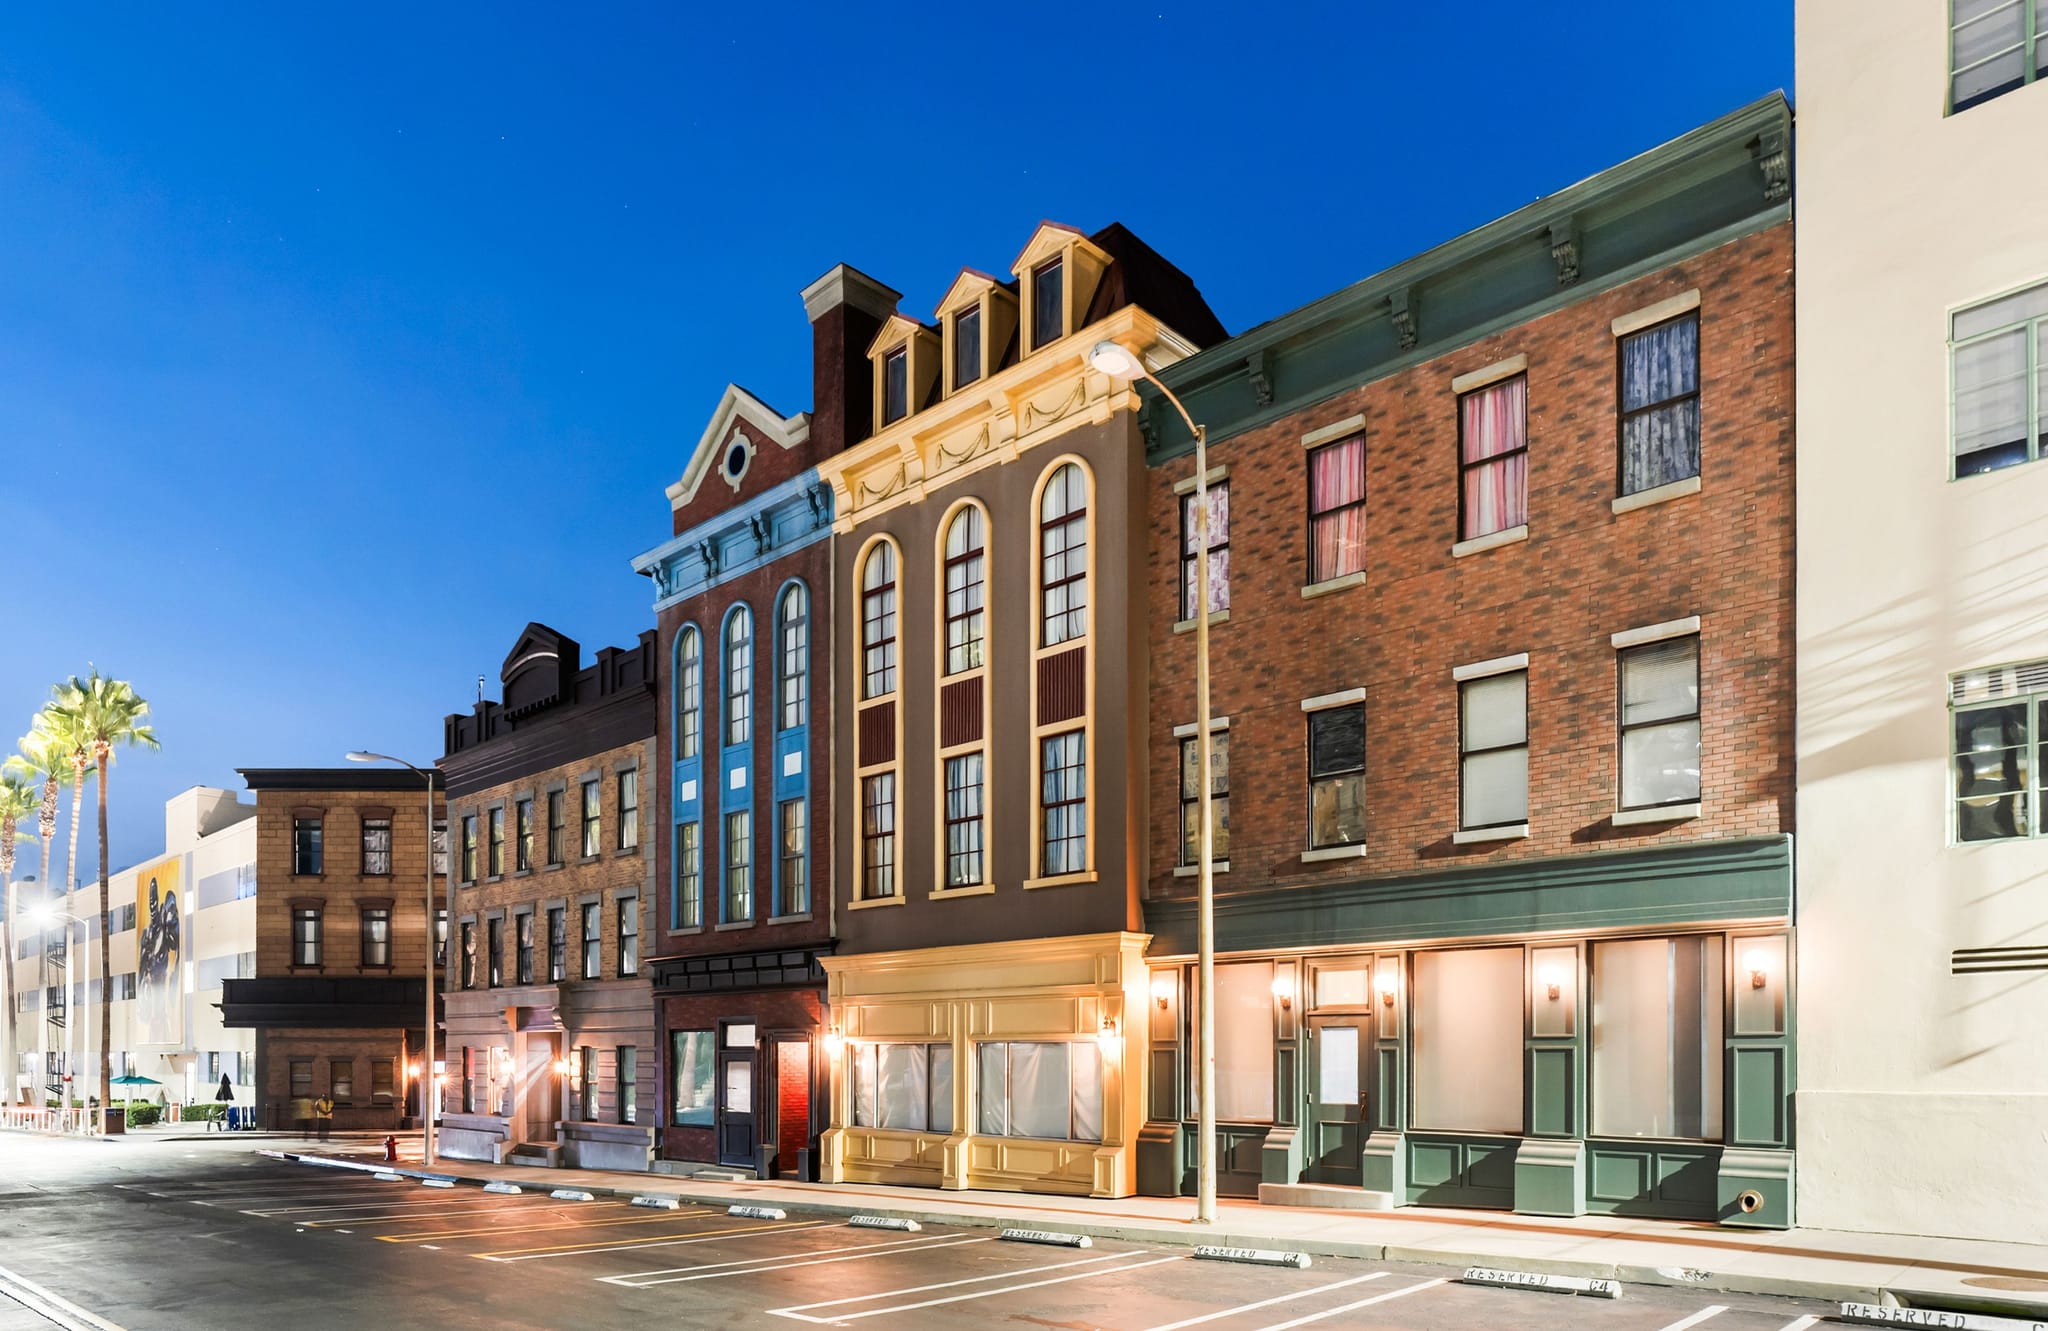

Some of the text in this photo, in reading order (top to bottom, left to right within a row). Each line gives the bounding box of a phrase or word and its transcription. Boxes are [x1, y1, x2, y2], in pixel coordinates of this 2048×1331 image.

[1004, 1229, 1050, 1240] RESERVED
[1196, 1246, 1256, 1258] RESERVED
[1466, 1268, 1609, 1293] RESERVED C4
[1846, 1303, 1967, 1329] RESERVED
